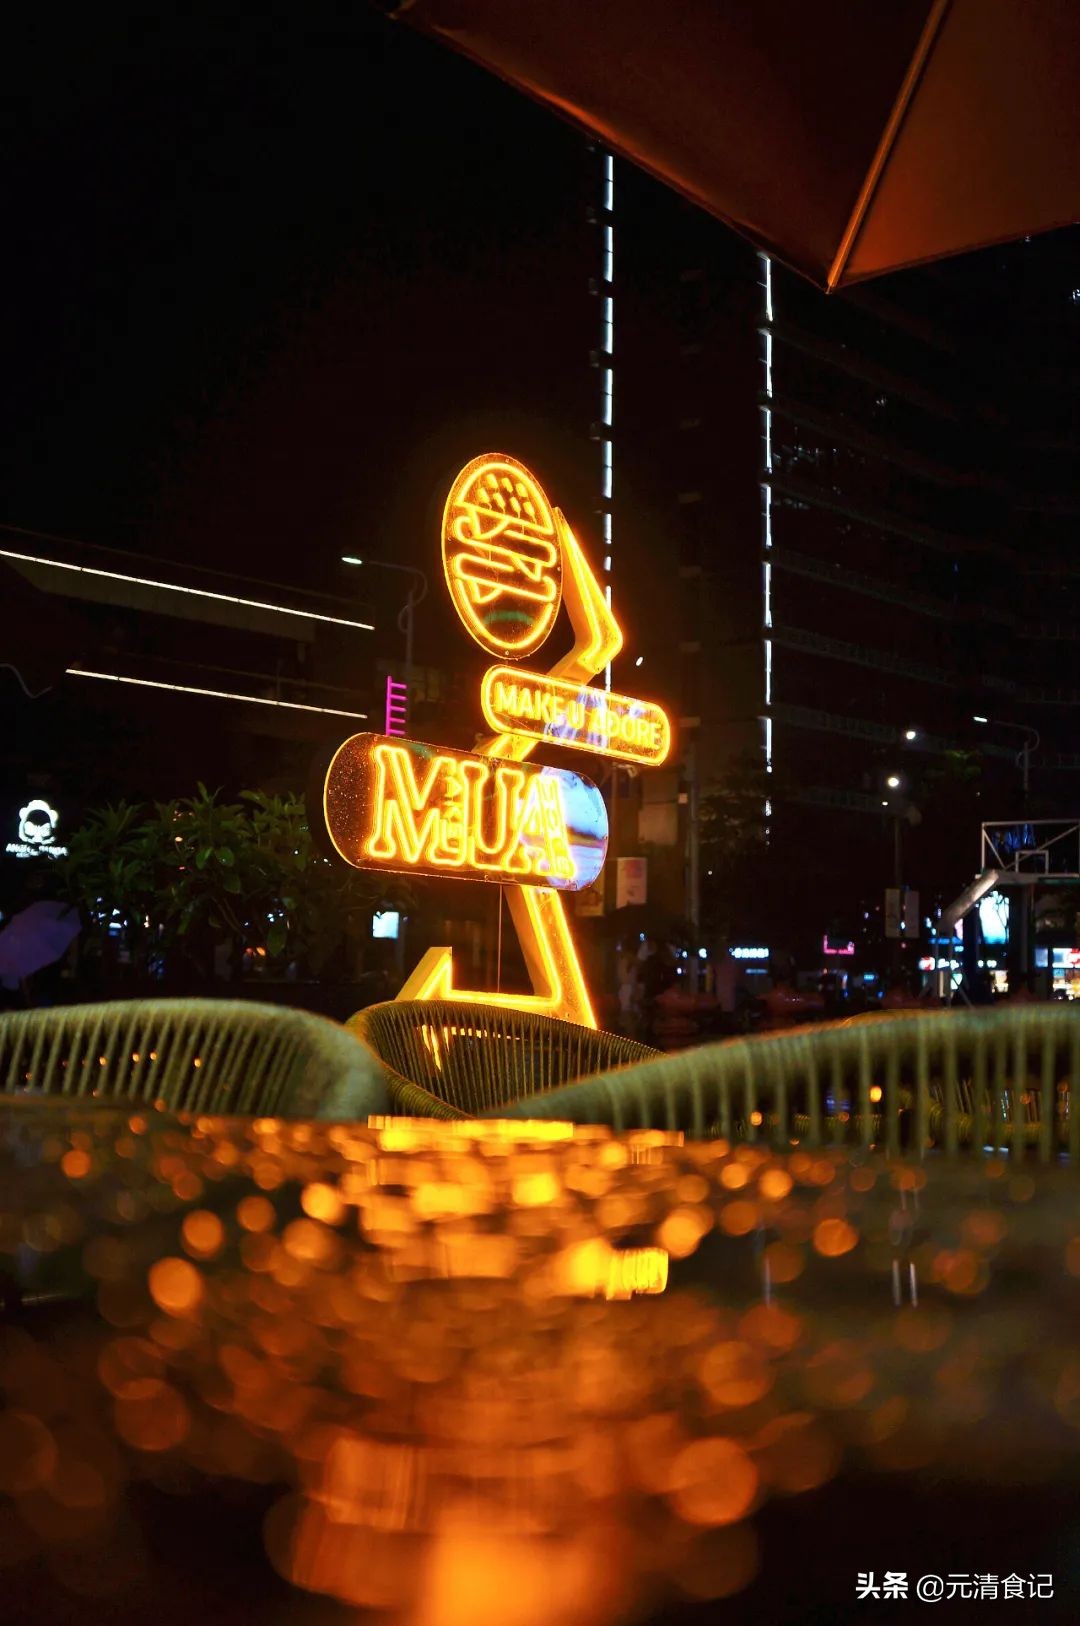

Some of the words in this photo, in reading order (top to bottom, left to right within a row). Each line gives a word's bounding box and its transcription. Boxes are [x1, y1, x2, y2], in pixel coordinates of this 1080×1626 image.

[494, 682, 564, 725] MAKE
[567, 701, 586, 730] U
[588, 709, 662, 750] ADORE
[368, 744, 576, 879] MUA
